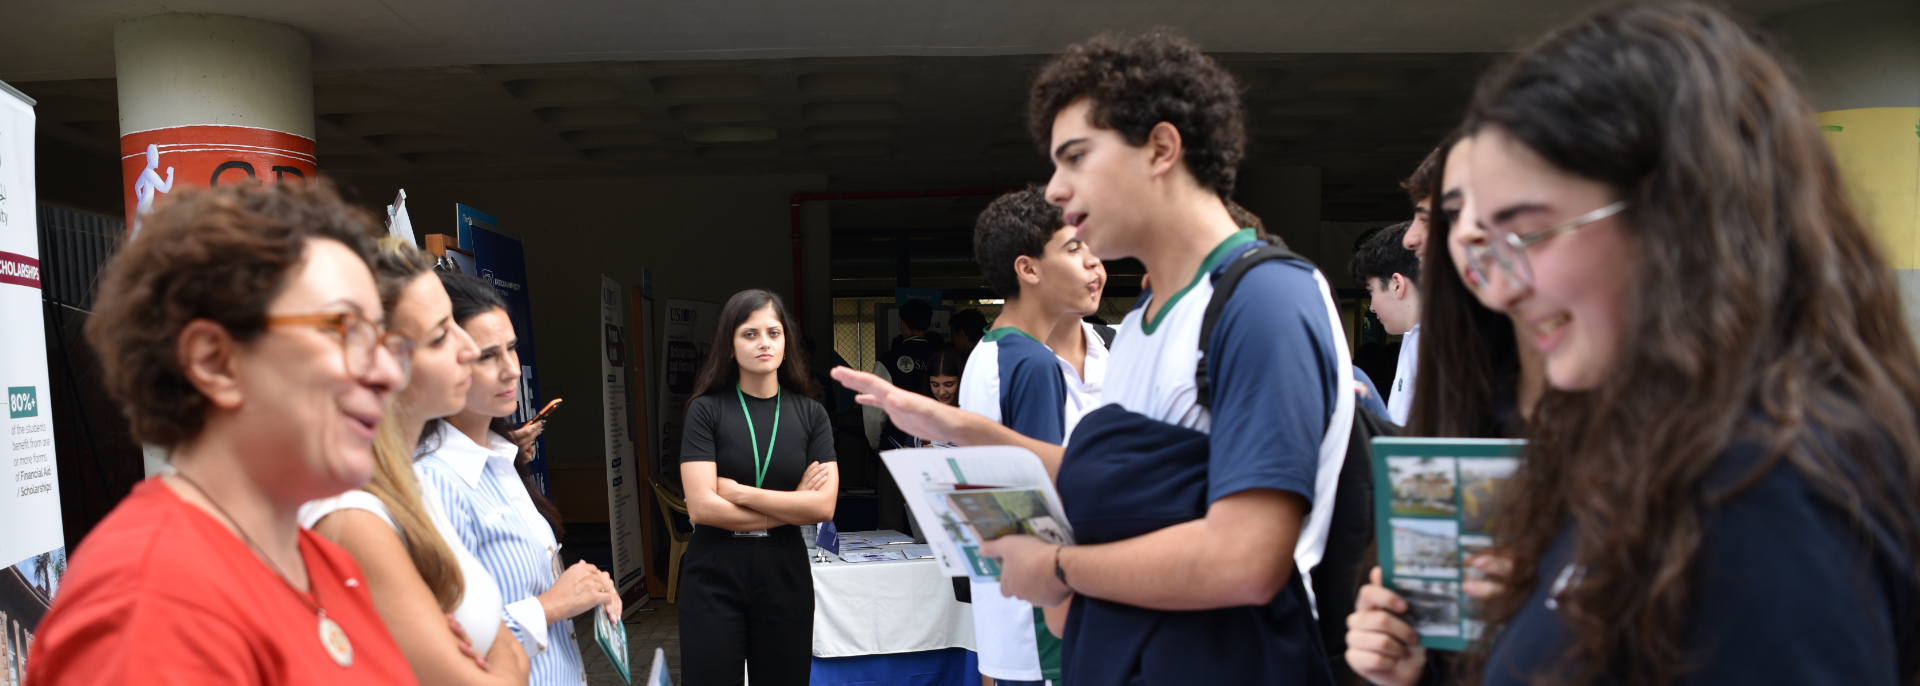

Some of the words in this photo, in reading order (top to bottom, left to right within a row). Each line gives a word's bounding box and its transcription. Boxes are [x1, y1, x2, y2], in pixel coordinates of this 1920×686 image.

[10, 392, 36, 412] 80%+
[11, 424, 16, 436] of
[17, 424, 25, 434] the
[26, 422, 46, 434] students
[12, 438, 29, 451] benefit
[30, 437, 41, 448] from
[42, 438, 50, 446] one
[14, 458, 19, 467] or
[20, 455, 33, 466] more
[33, 452, 47, 464] forms
[15, 471, 20, 482] of
[20, 467, 43, 481] Financial
[43, 466, 51, 477] Aid
[20, 482, 52, 497] Scholarships
